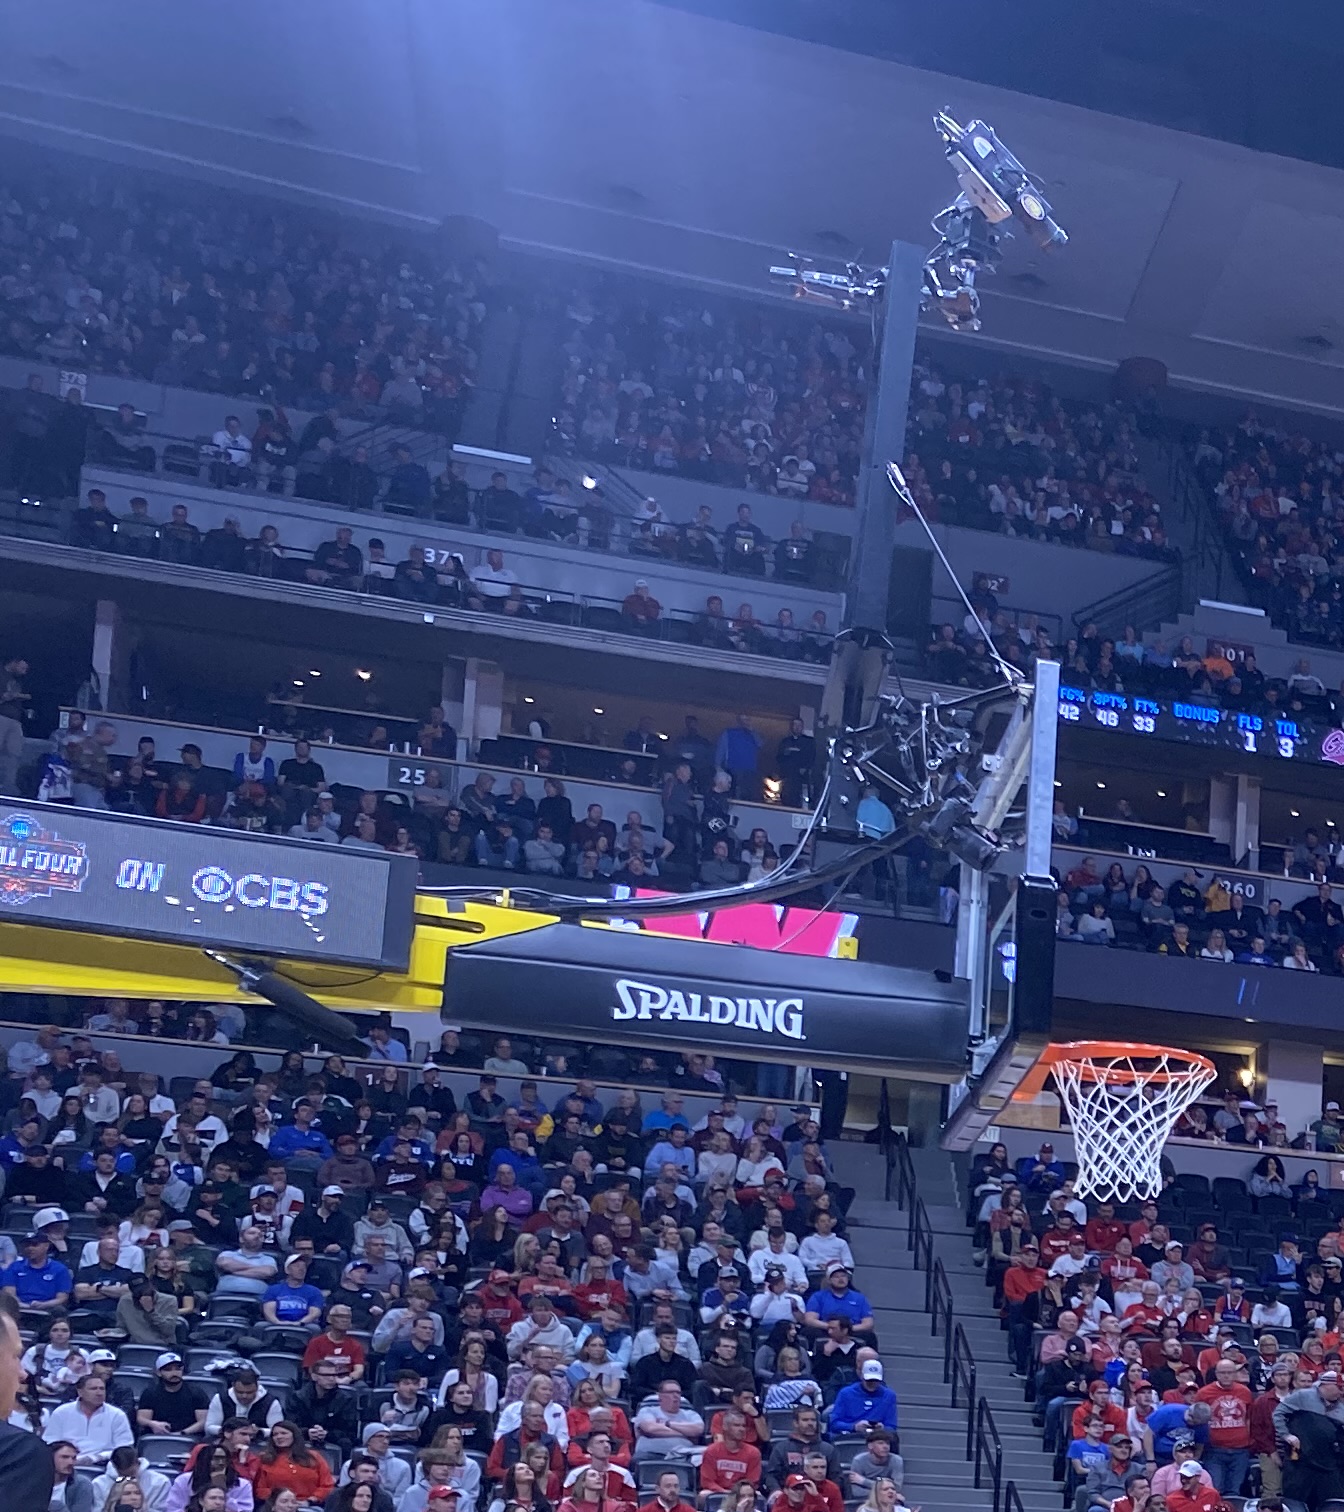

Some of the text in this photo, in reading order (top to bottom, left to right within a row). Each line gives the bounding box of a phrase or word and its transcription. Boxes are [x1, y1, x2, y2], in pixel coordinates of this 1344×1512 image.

[1059, 686, 1300, 739] FG% 3PT% FT% BONUS FLS TOL
[1244, 730, 1258, 754] 1
[1279, 737, 1295, 759] 3
[398, 767, 426, 785] 25
[21, 849, 83, 876] FOUR
[115, 858, 166, 893] ON
[235, 873, 329, 916] CBS
[612, 978, 807, 1041] SPALDING
